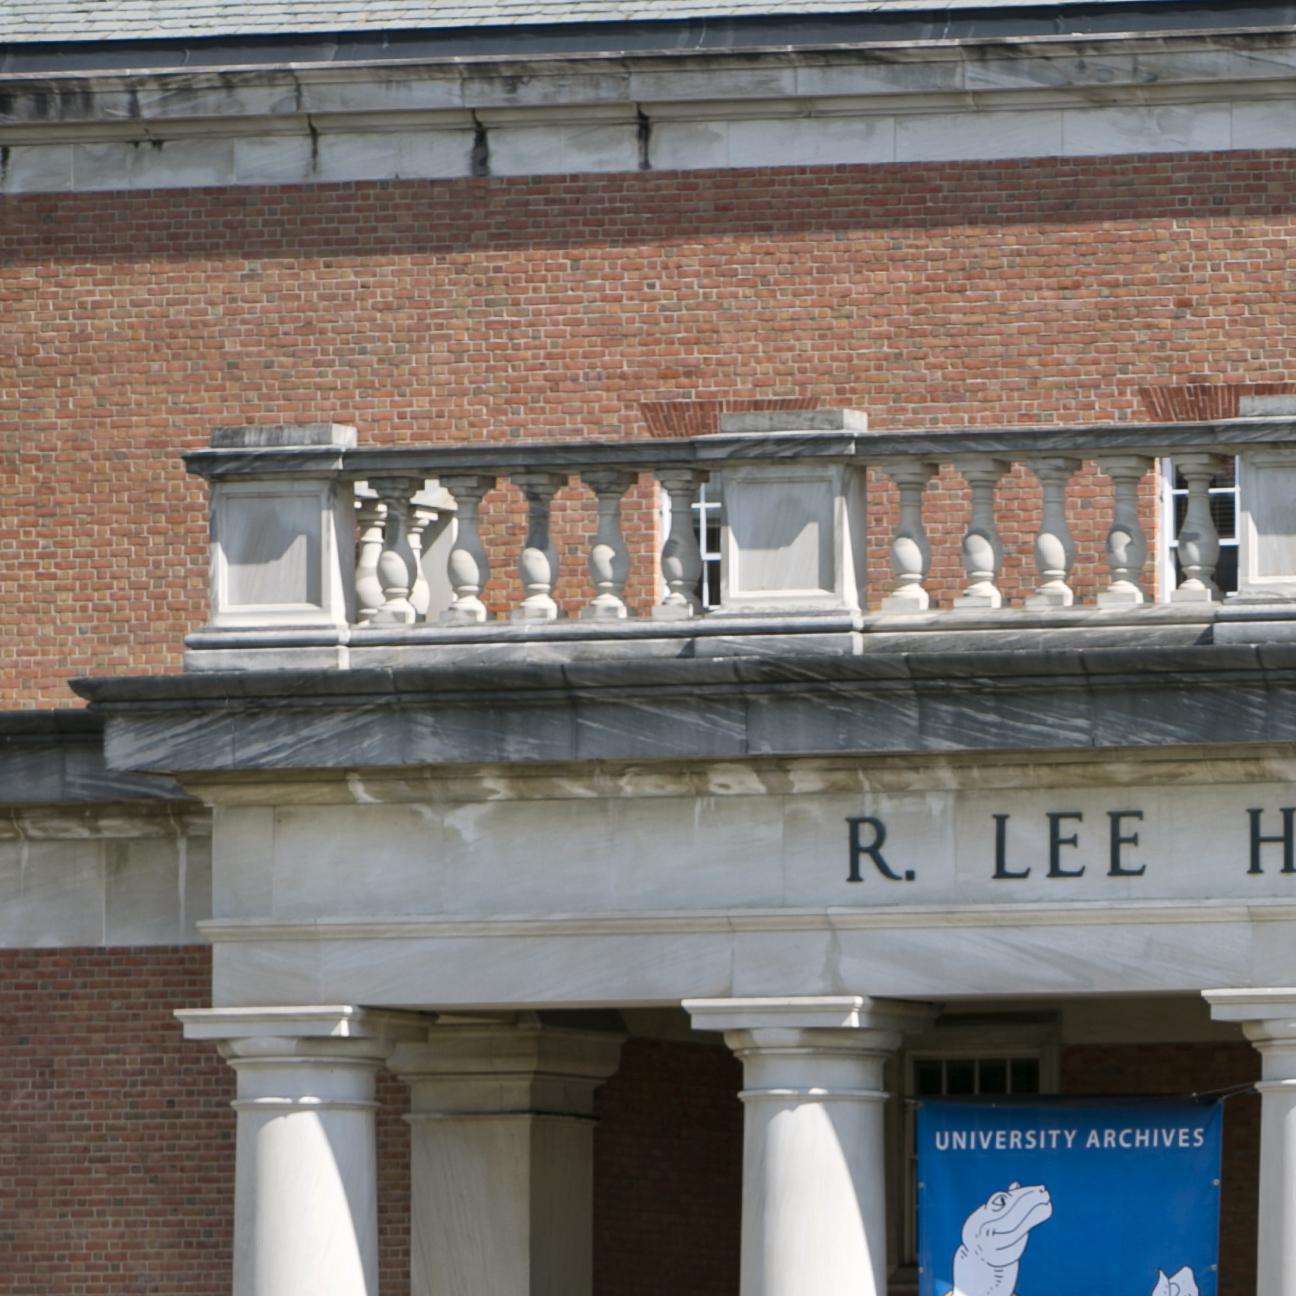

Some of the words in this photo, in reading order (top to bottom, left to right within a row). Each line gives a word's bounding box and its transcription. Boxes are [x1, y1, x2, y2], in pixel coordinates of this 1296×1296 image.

[845, 815, 917, 883] R.
[991, 809, 1147, 881] LEE
[934, 1130, 1077, 1151] UNIVERSITY
[1085, 1128, 1205, 1149] ARCHIVES
